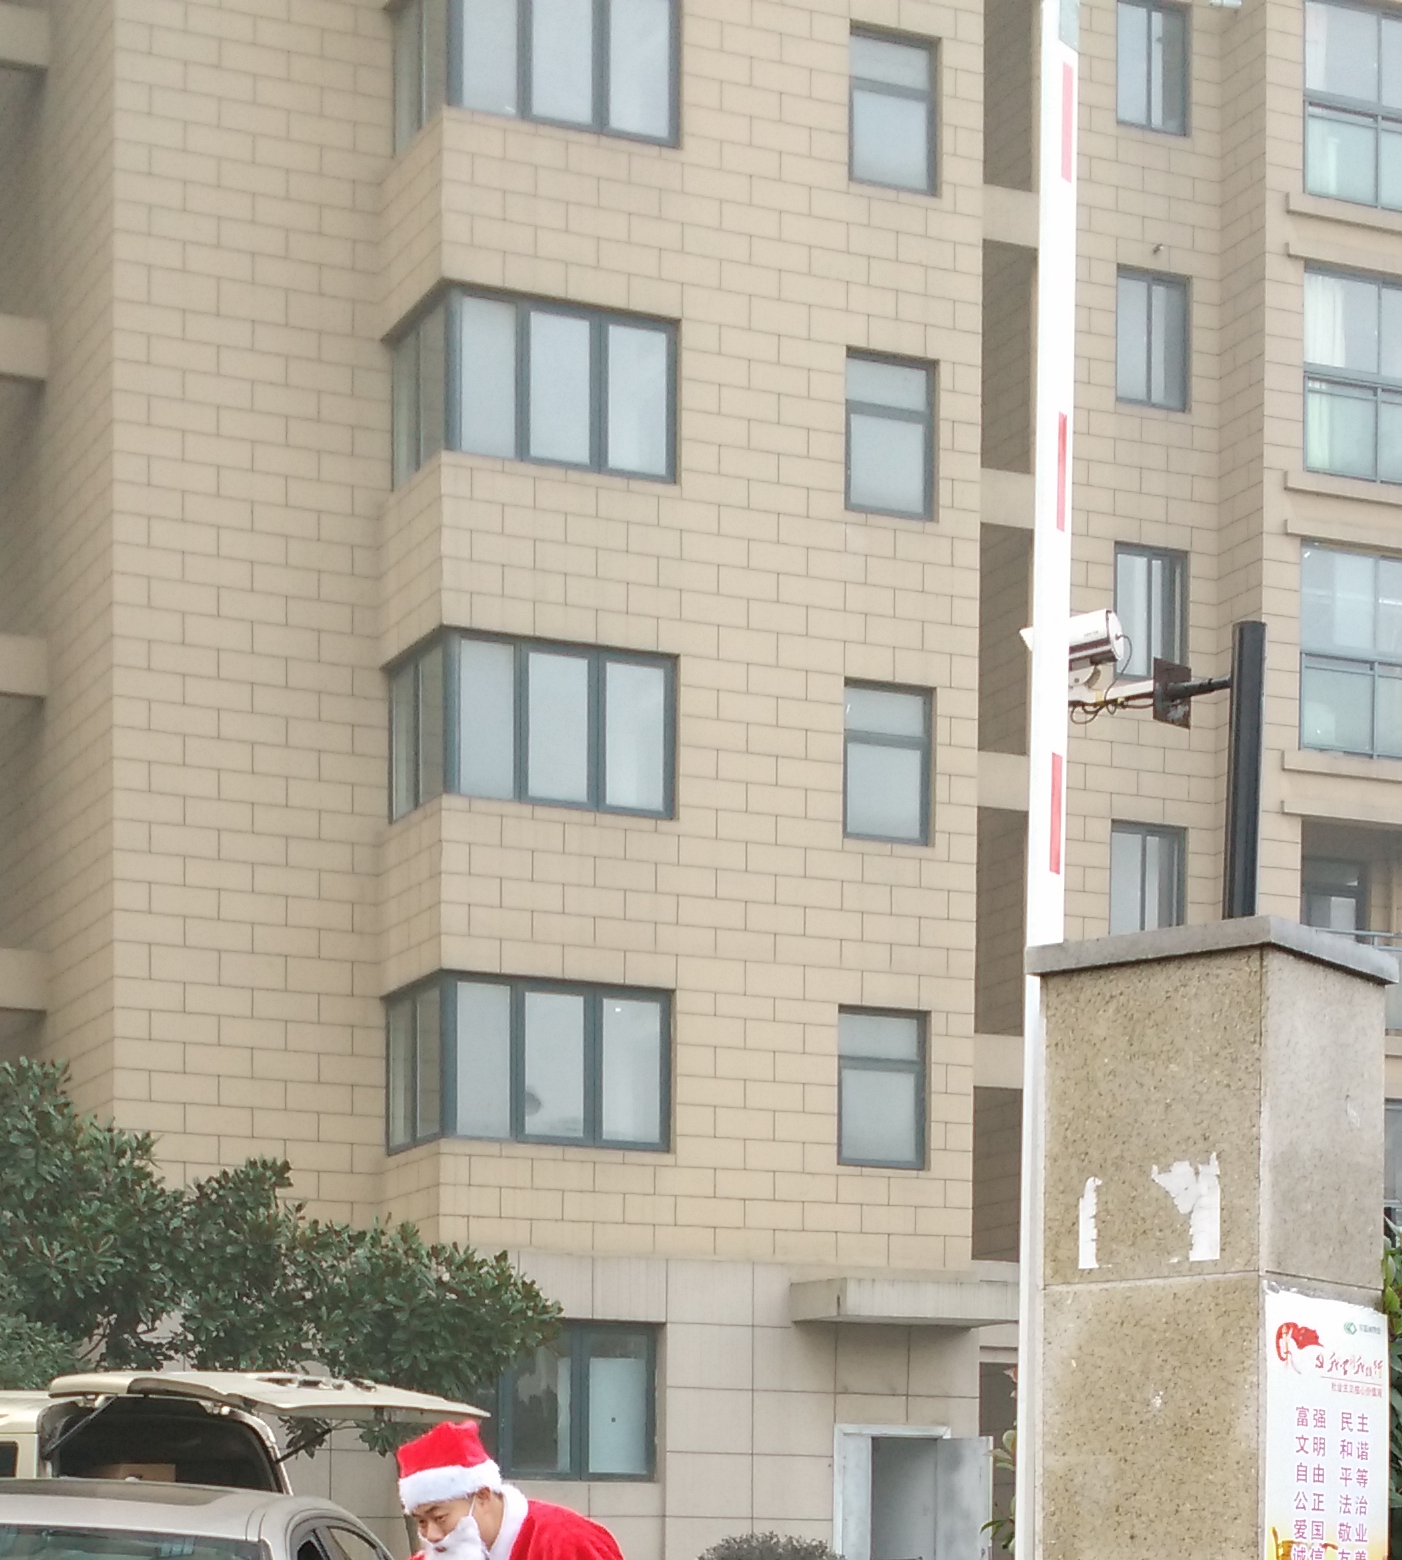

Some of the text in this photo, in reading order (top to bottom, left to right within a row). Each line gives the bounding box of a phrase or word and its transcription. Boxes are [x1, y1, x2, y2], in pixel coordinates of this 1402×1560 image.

[1296, 1406, 1369, 1433] 富强 民主
[1295, 1434, 1369, 1460] 文明 和谐
[1296, 1462, 1369, 1488] 自由 平等
[1293, 1491, 1368, 1516] 公正 法治
[1293, 1519, 1368, 1542] 爱国 敬业
